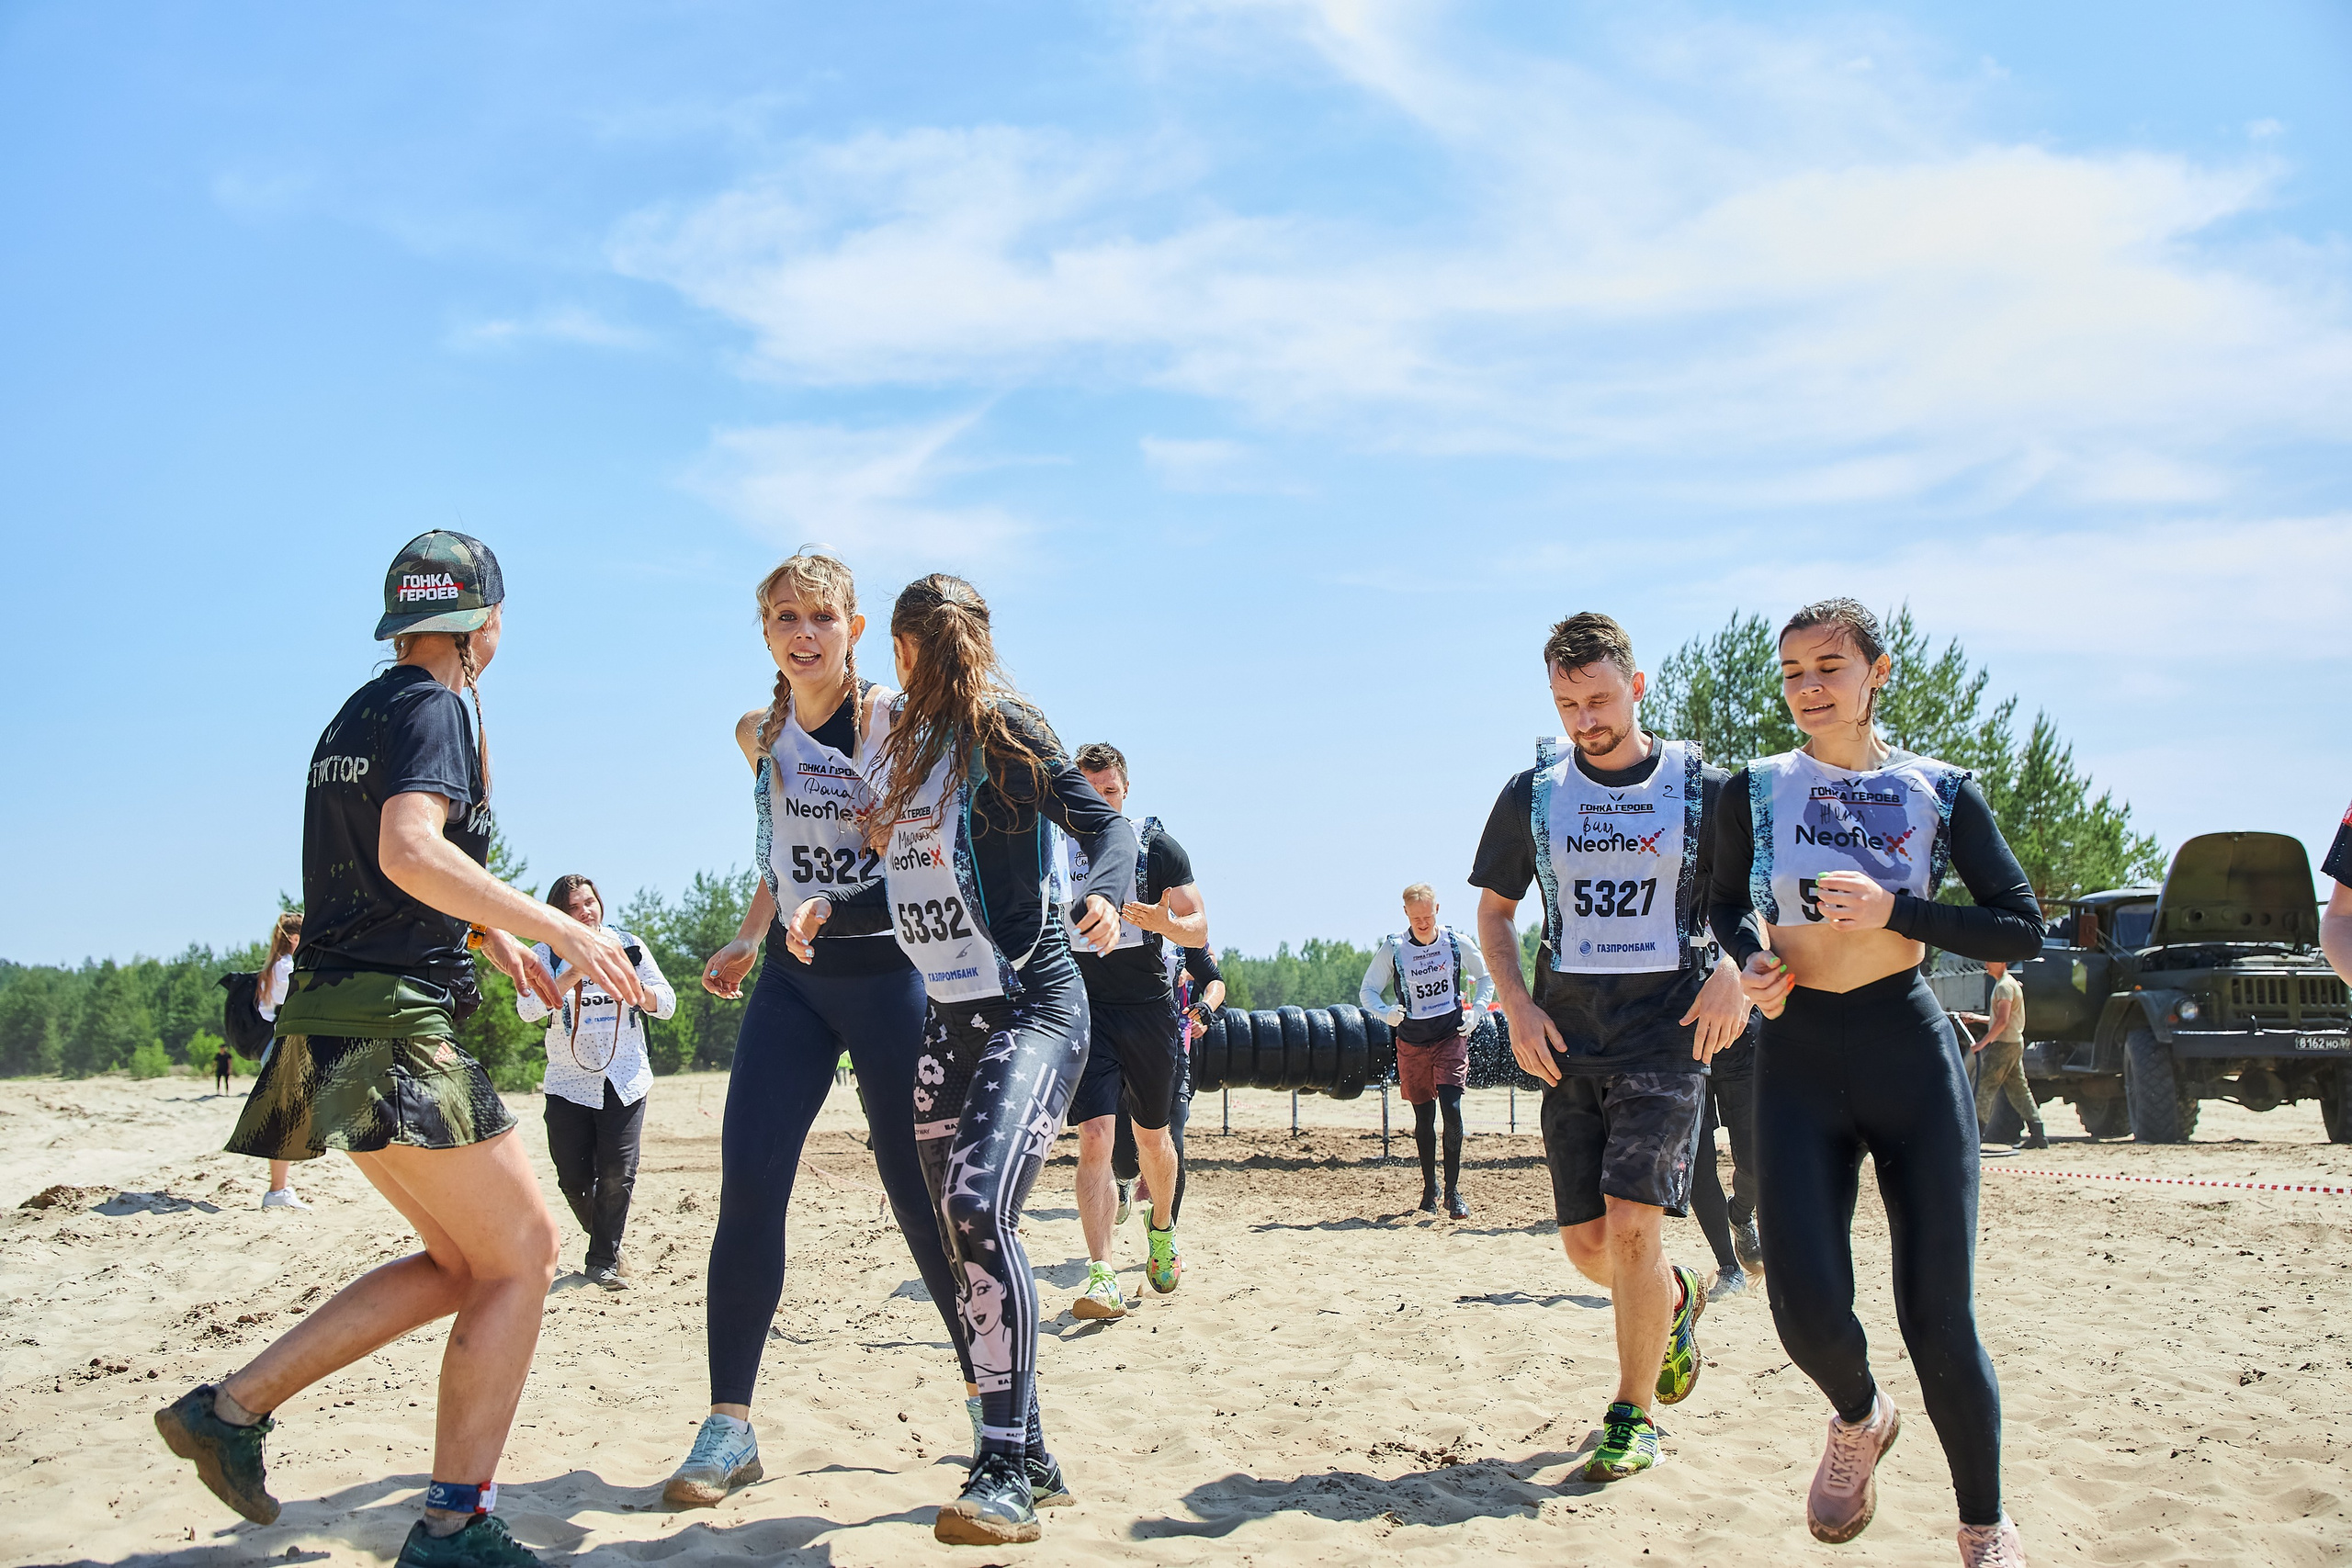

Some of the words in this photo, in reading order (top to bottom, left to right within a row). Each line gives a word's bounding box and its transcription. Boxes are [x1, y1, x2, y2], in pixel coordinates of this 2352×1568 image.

[402, 572, 454, 588] ГОНКА
[399, 586, 458, 602] ГЕРОЕВ
[798, 762, 826, 773] ГОНКА
[1811, 786, 1848, 801] ГОНКА
[1851, 791, 1900, 804] ГЕРОЕВ
[1579, 803, 1612, 813] ГОНКА
[1615, 803, 1654, 813] ГЕРОЕВ
[1566, 828, 1666, 857] Neoflex
[1796, 825, 1917, 862] Neoflex
[791, 845, 882, 885] 5322
[1574, 878, 1657, 918] 5327
[898, 897, 973, 944] 5332
[1597, 942, 1657, 953] ГАЗПРОМБАНК
[928, 966, 979, 983] ГАЗПРОМБАНК
[1411, 960, 1447, 976] Neoflex
[1416, 979, 1449, 999] 5326
